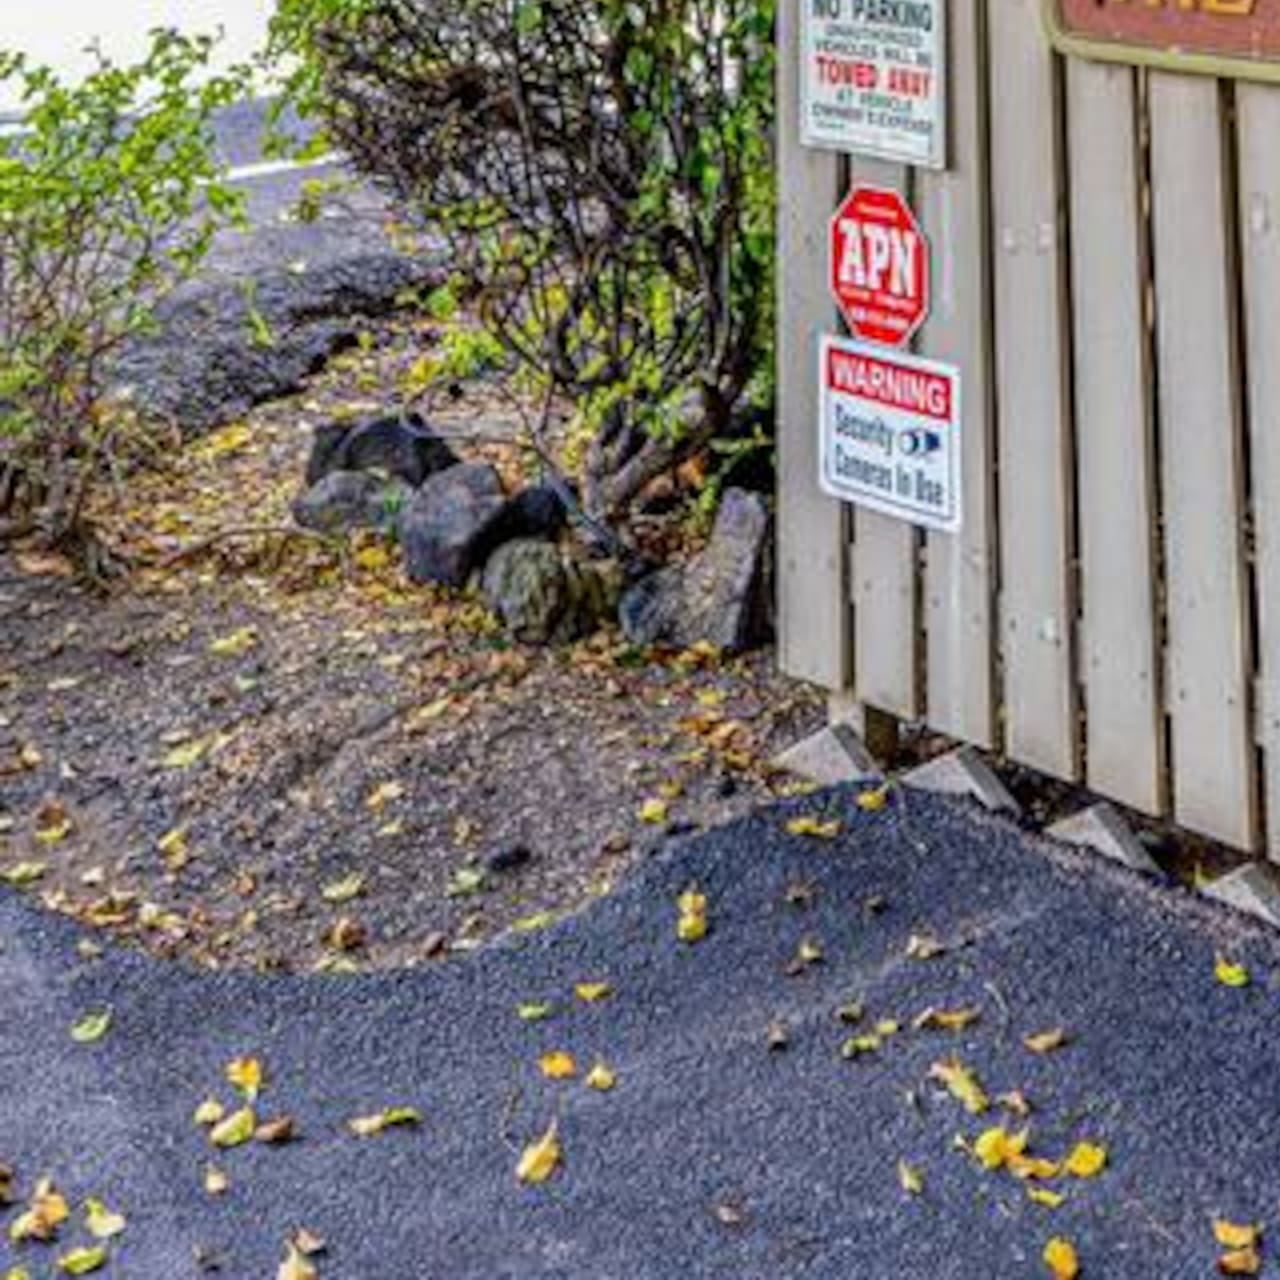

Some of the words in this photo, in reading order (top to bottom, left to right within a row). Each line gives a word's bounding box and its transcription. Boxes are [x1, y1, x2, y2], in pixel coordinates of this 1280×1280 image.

[816, 56, 876, 88] TOWED
[888, 66, 930, 100] AWAY
[839, 219, 917, 299] APN
[831, 352, 947, 416] WARNING
[835, 403, 894, 456] Security
[835, 443, 892, 491] Cameras
[915, 468, 943, 506] Use
